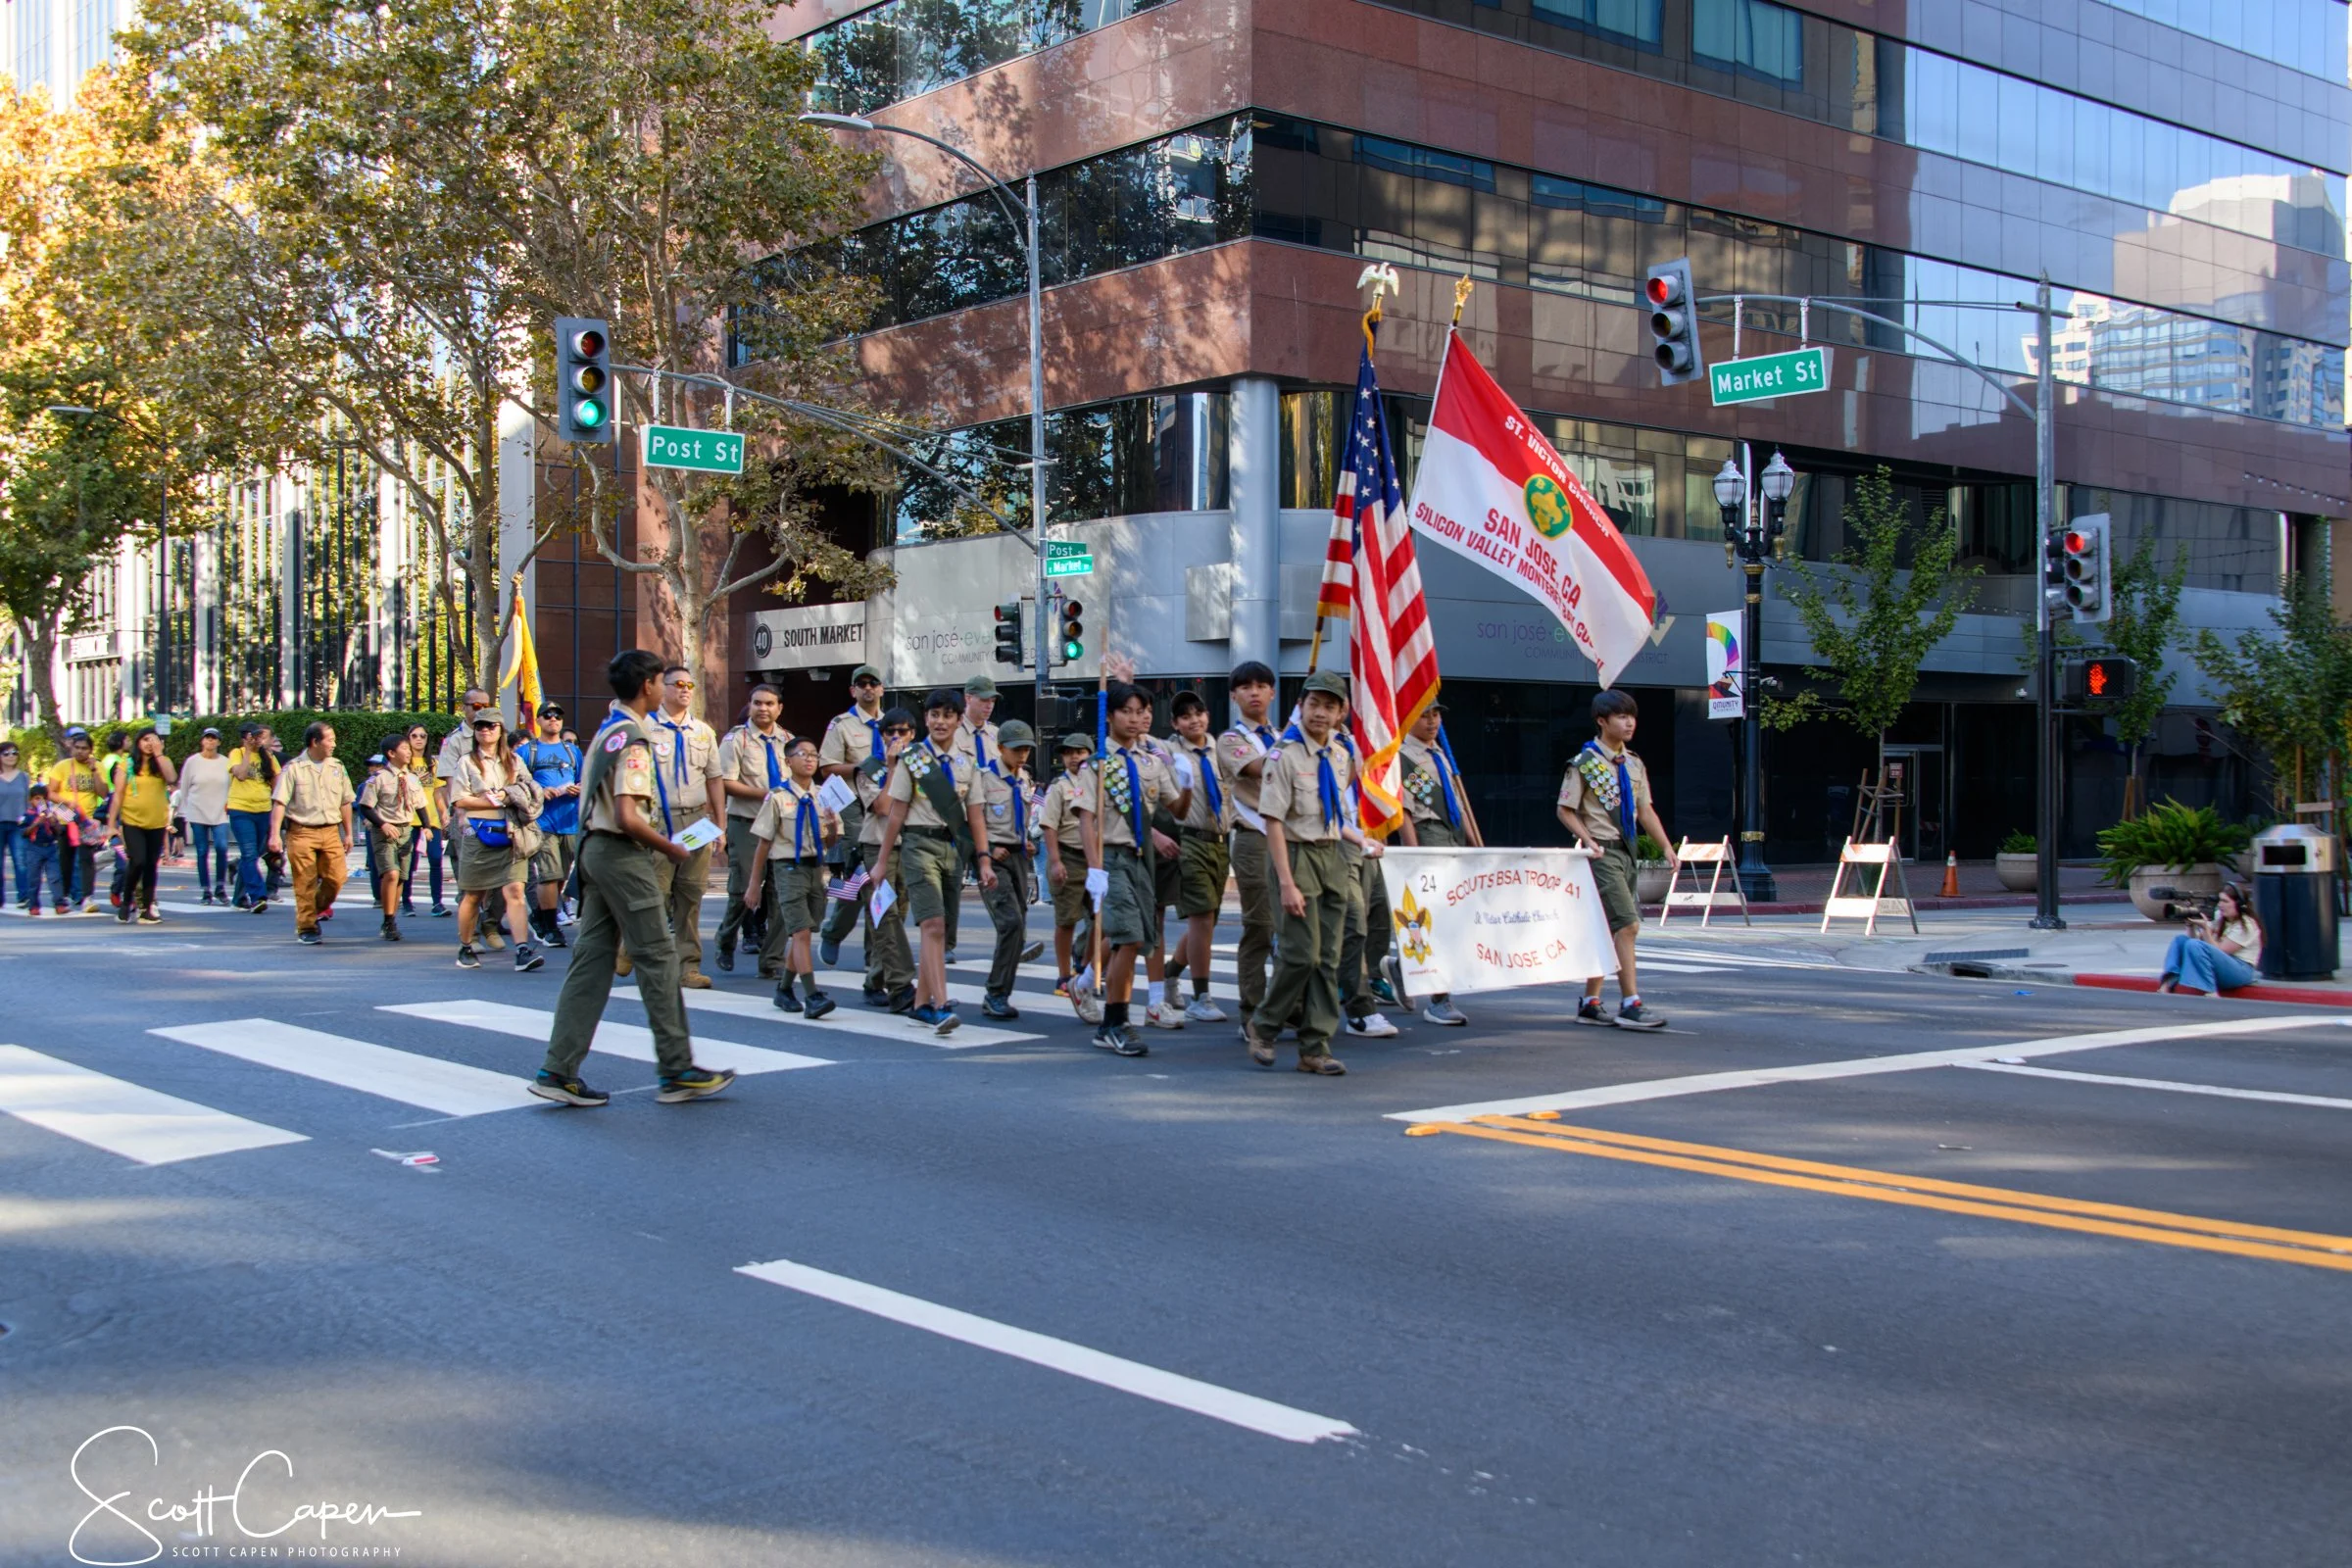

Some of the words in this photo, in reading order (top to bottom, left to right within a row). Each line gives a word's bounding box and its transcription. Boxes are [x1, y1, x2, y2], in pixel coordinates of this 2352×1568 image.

[1717, 365, 1784, 394] Market
[1794, 360, 1818, 382] St
[652, 435, 702, 460] Post
[713, 441, 739, 464] St
[1504, 415, 1524, 441] ST.
[1527, 432, 1568, 485] VICTOR
[1414, 502, 1466, 543] SILICON
[1466, 530, 1517, 568] VALLEY
[1049, 544, 1073, 557] Post
[1483, 508, 1522, 549] SAN
[1561, 574, 1582, 610] CA
[1053, 560, 1082, 572] Market
[755, 631, 767, 650] 40
[784, 627, 817, 648] SOUTH
[819, 622, 863, 645] MARKET
[906, 635, 929, 651] san
[1477, 621, 1508, 639] san
[1421, 874, 1437, 893] 24
[1446, 873, 1495, 906] SCOUTS
[1495, 869, 1522, 886] BSA
[1524, 869, 1562, 891] TROOP
[1564, 882, 1581, 900] 41
[1476, 943, 1503, 968] SAN
[1544, 938, 1568, 960] CA
